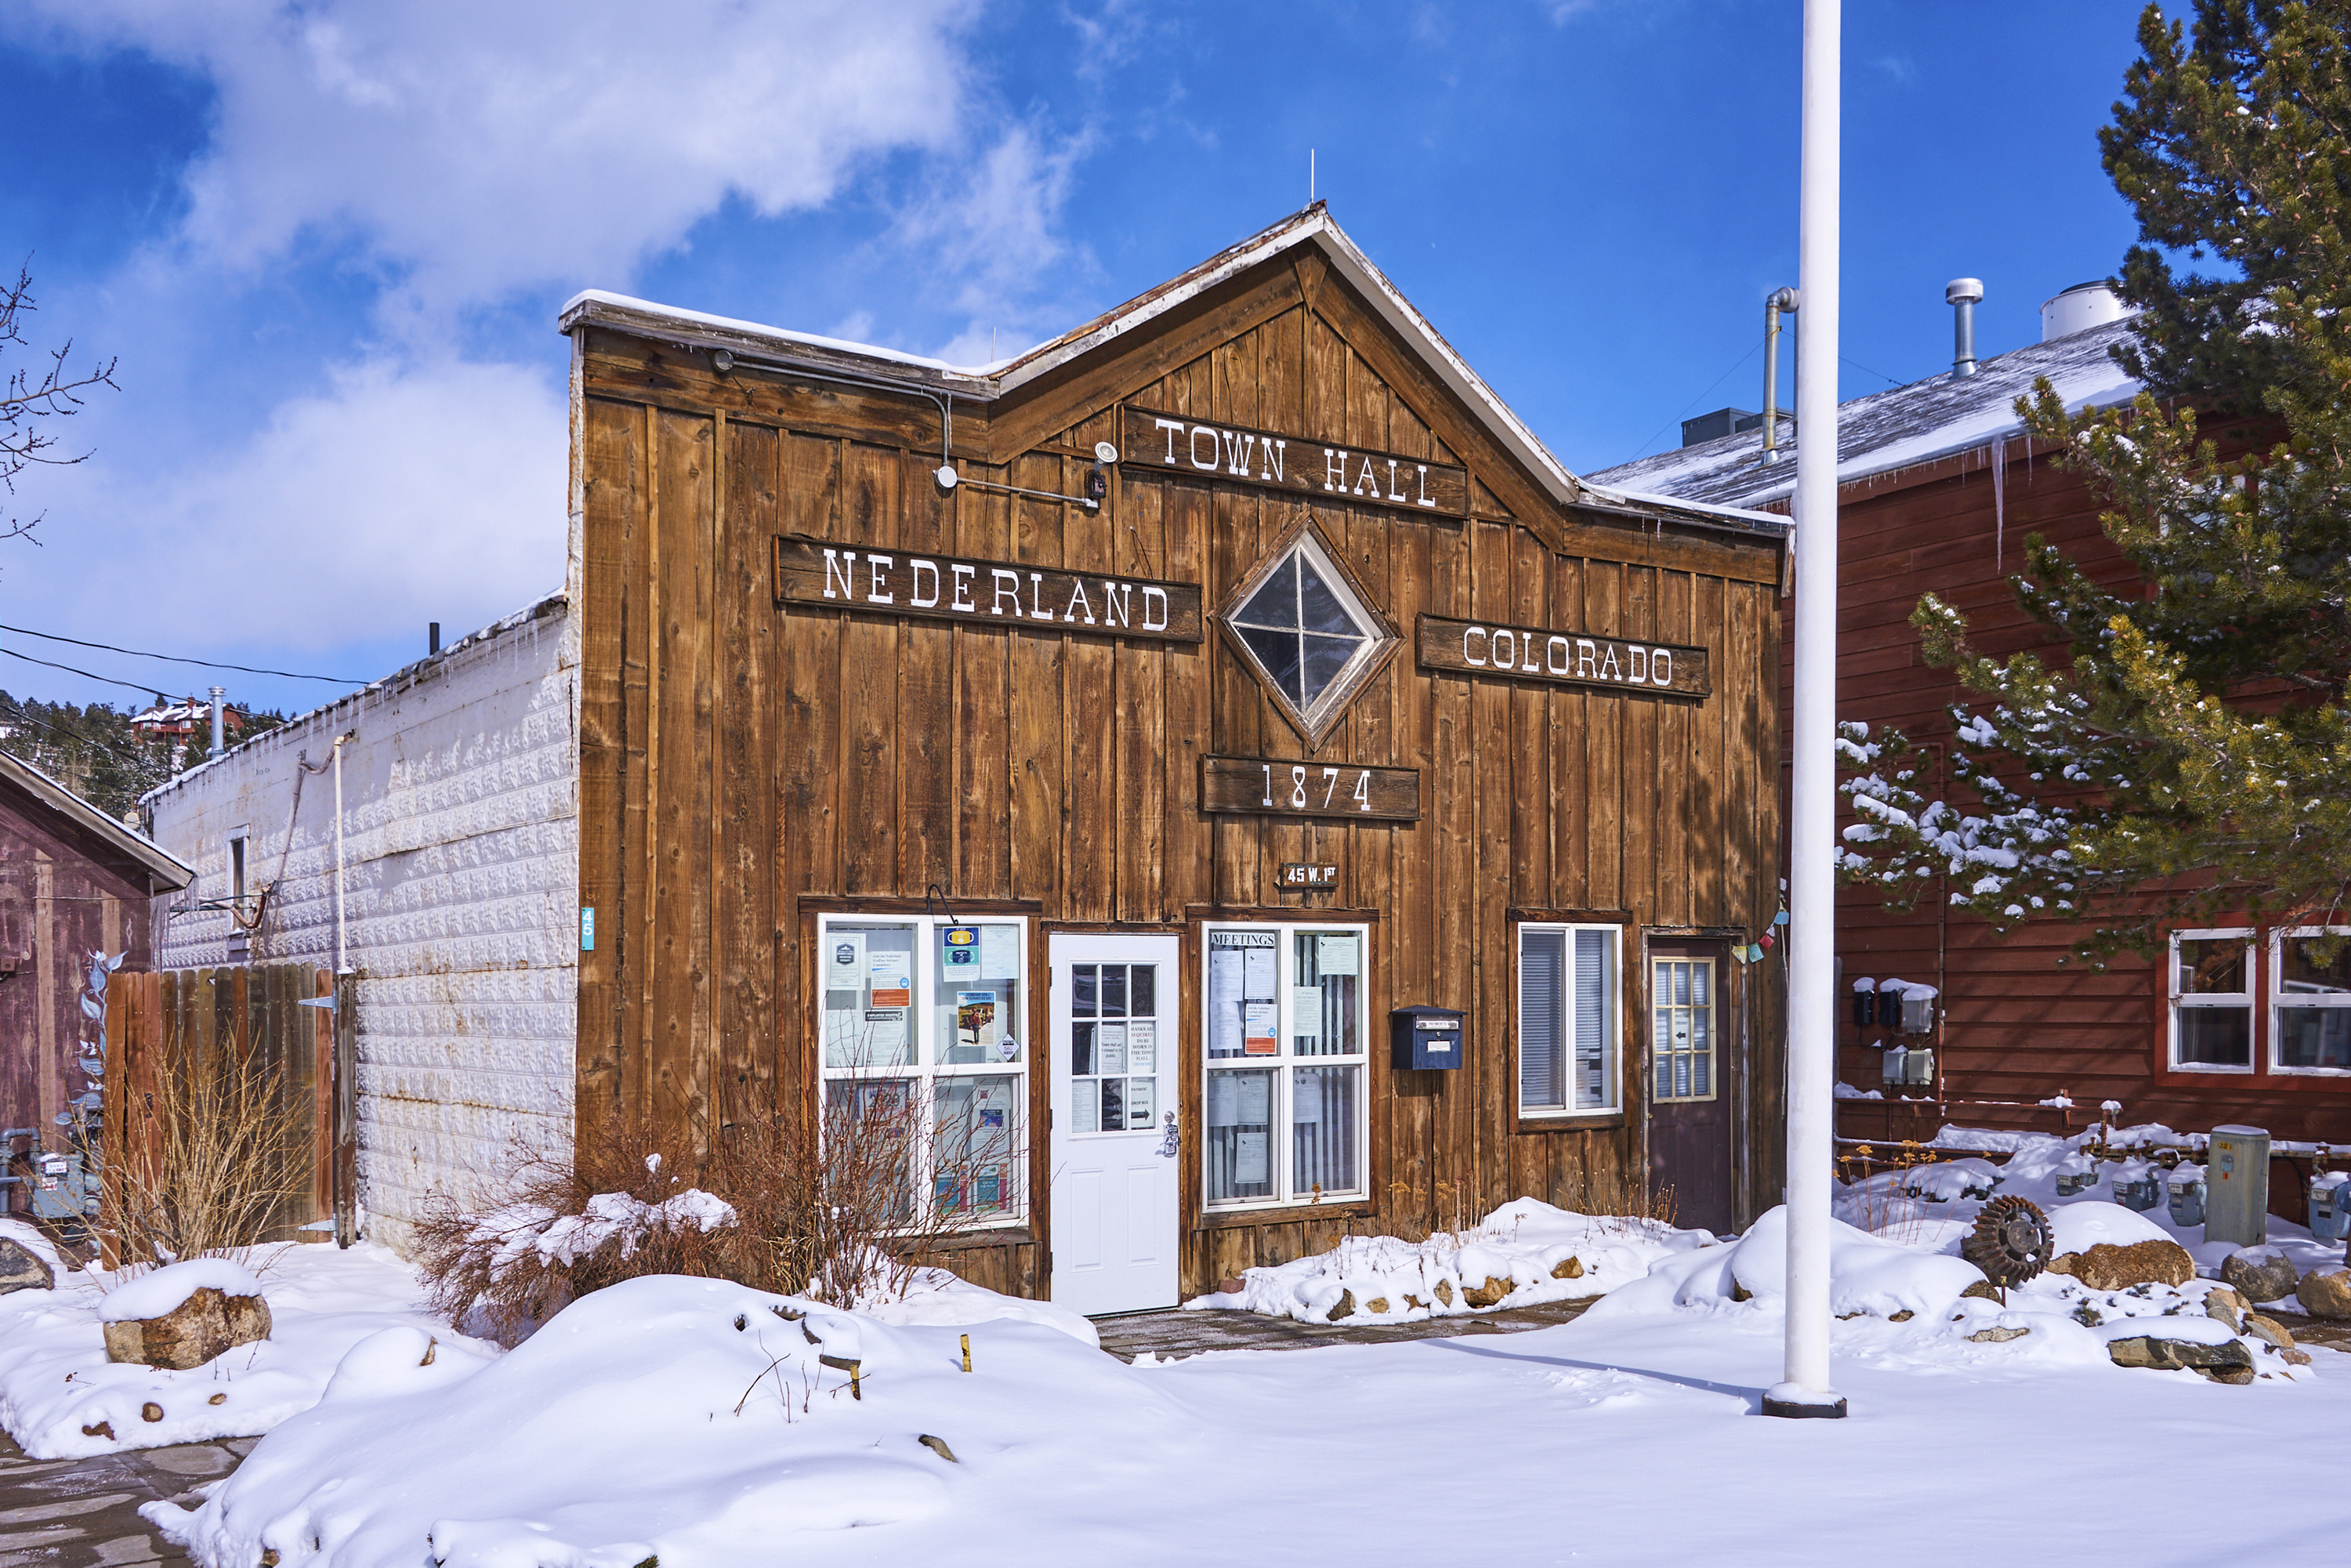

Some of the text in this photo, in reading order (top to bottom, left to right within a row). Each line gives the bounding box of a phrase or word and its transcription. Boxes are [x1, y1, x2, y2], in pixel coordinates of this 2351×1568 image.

[1155, 418, 1436, 508] TOWN HALL
[823, 549, 1168, 632] NEDERLAND
[1463, 626, 1672, 686] COLORADO
[1262, 764, 1371, 812] 1874
[1288, 867, 1336, 883] 45 W. 1ST
[582, 910, 593, 936] 45
[1213, 933, 1275, 946] MEETINGS
